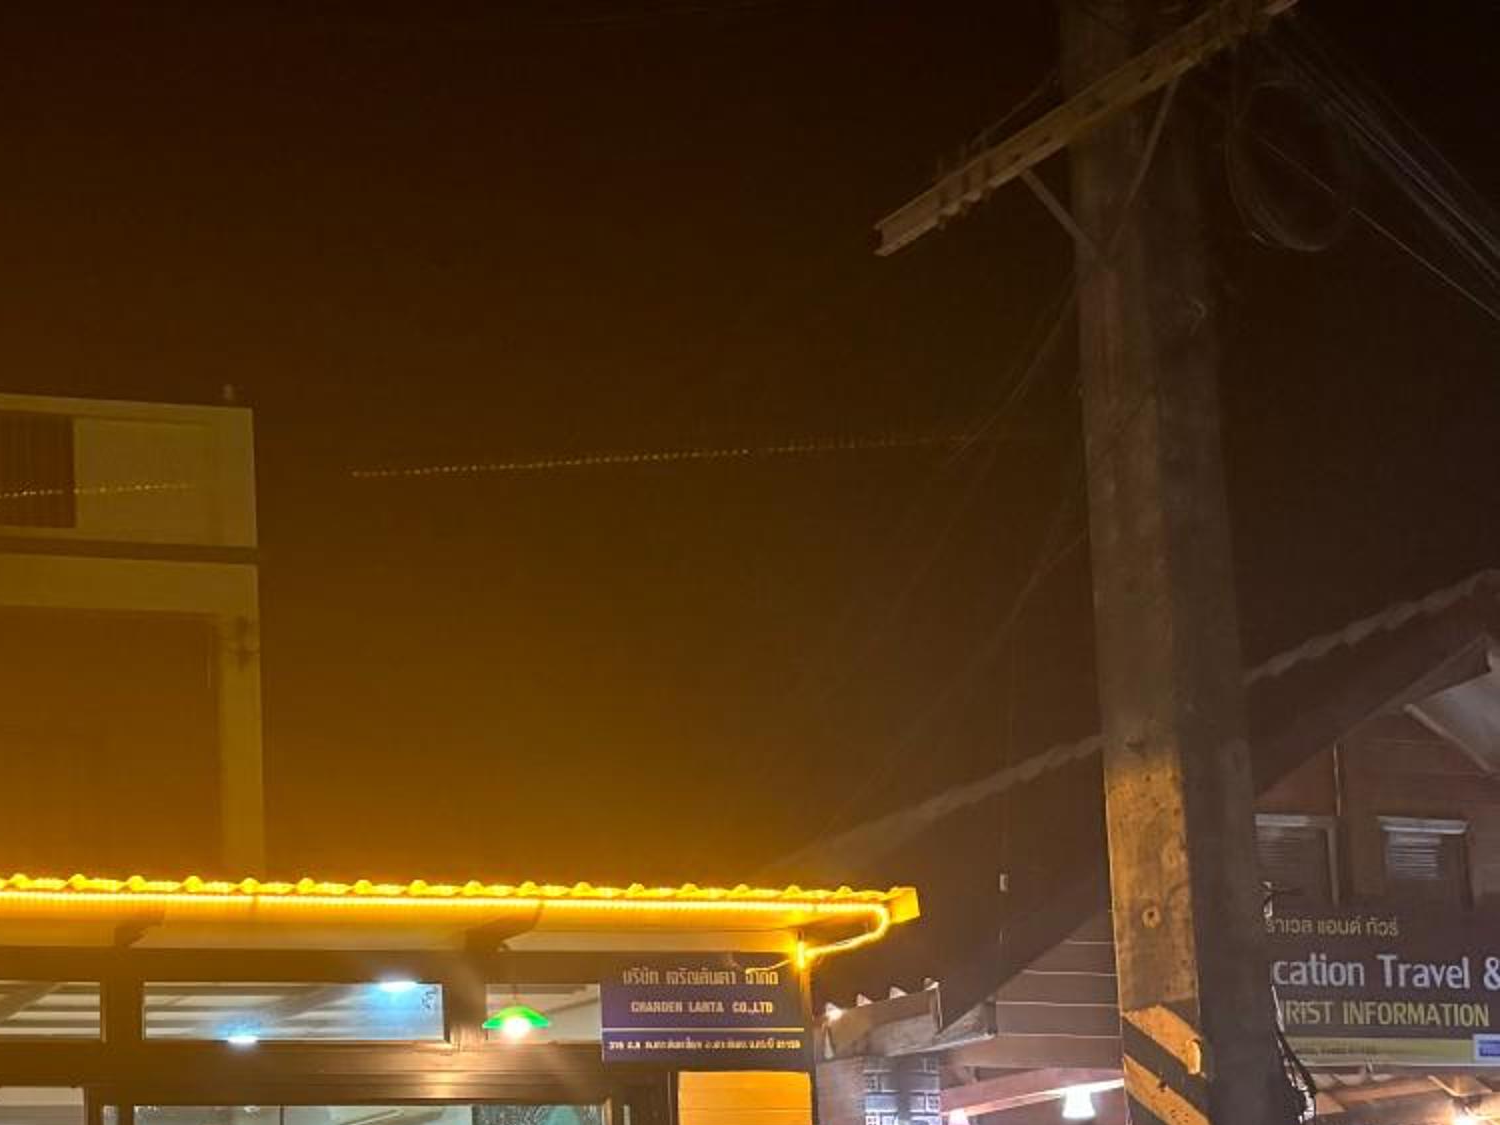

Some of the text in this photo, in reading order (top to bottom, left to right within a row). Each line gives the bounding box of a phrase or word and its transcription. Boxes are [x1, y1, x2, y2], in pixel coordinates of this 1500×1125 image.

[1273, 952, 1365, 987] cation
[1376, 953, 1472, 990] Travel
[1343, 1001, 1490, 1027] INFORMATION
